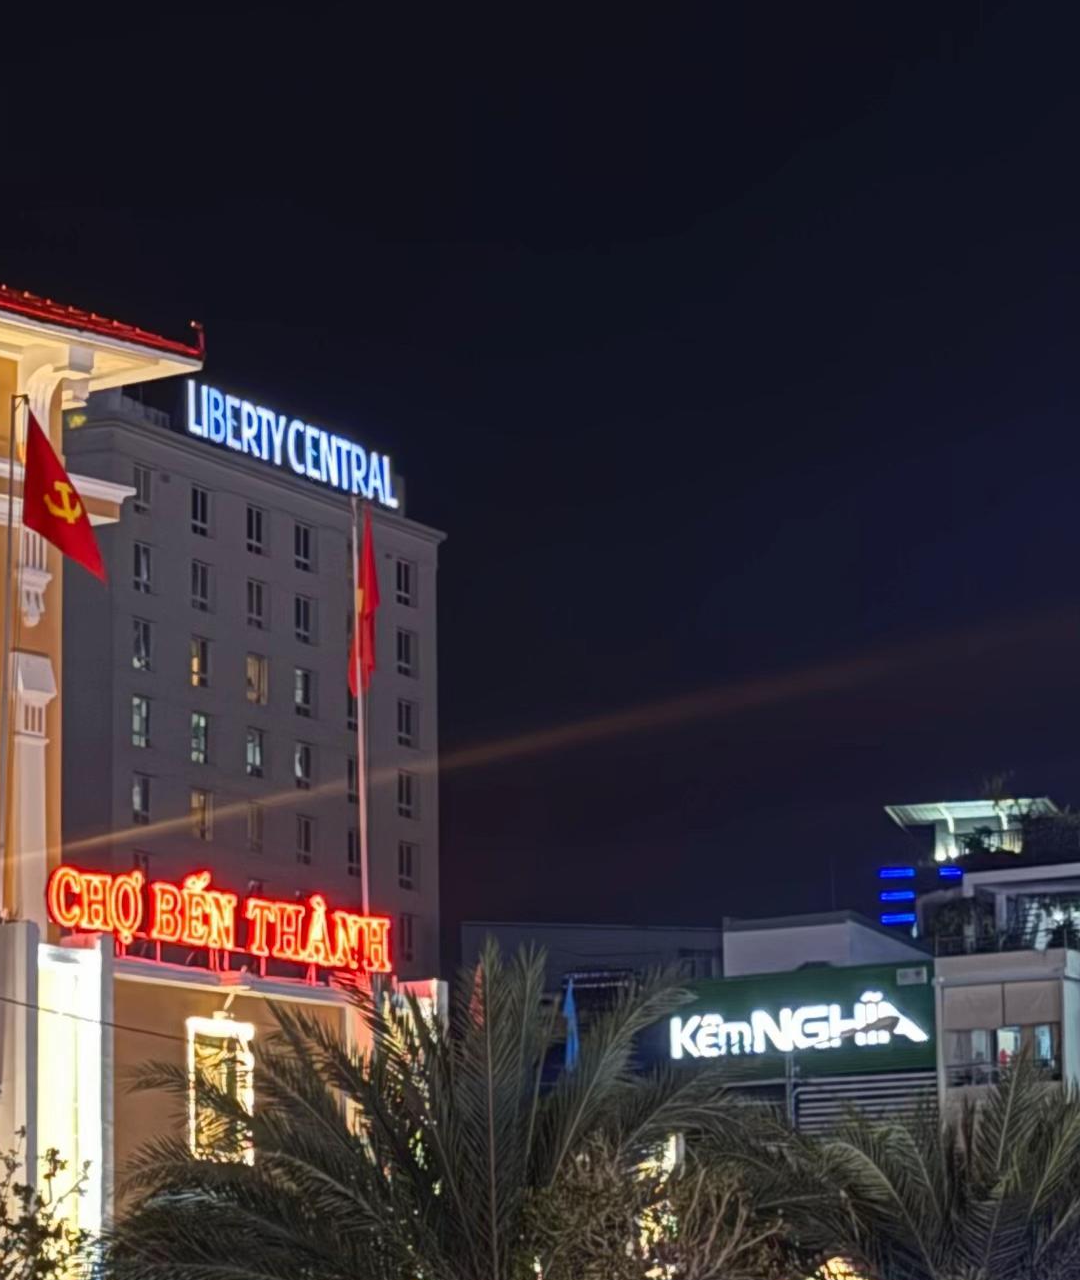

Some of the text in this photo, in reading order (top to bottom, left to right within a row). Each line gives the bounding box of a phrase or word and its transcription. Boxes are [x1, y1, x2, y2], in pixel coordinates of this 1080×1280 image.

[188, 379, 399, 509] LIBERTY CENTRAL
[49, 867, 393, 973] CHỢ BẾN THÀNH
